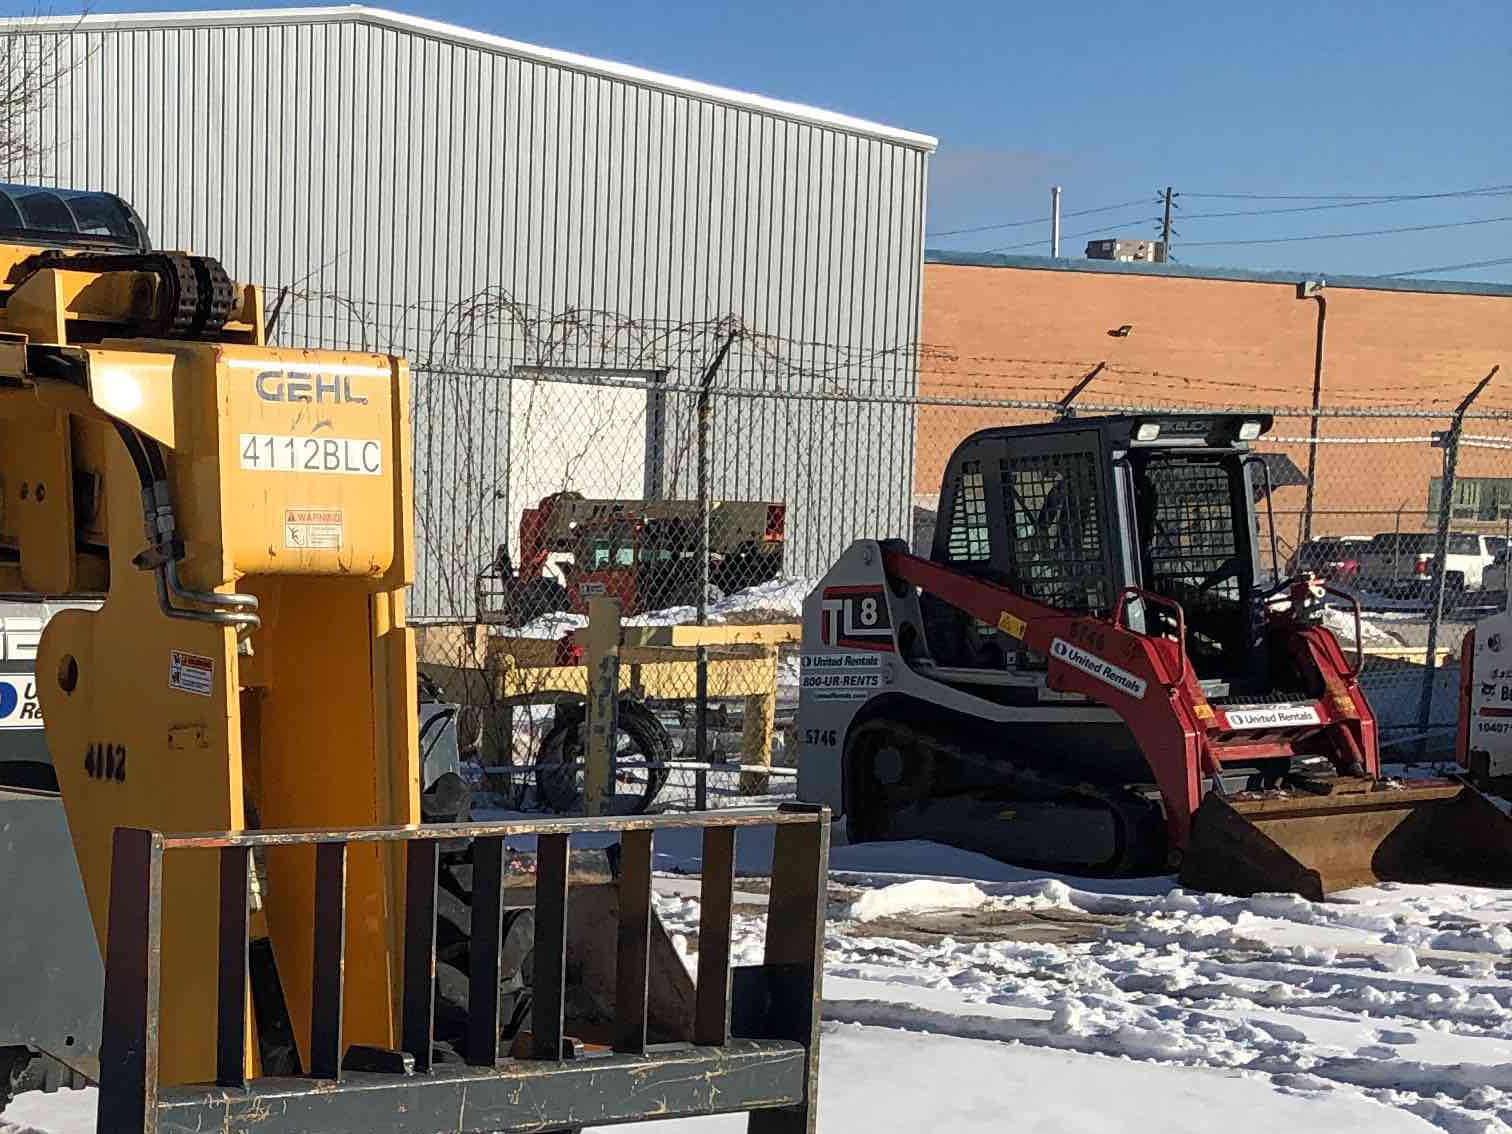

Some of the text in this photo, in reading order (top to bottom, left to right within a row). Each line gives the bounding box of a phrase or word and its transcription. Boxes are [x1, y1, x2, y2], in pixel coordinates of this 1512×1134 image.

[255, 370, 369, 406] GEHL
[242, 436, 381, 474] 4112BLC
[822, 598, 894, 647] TL8
[814, 655, 878, 666] United Rentals
[1068, 648, 1140, 692] United Rentals
[803, 675, 879, 686] 800-UR-RENTS
[1245, 711, 1313, 724] United Rentals
[806, 728, 837, 746] 5746
